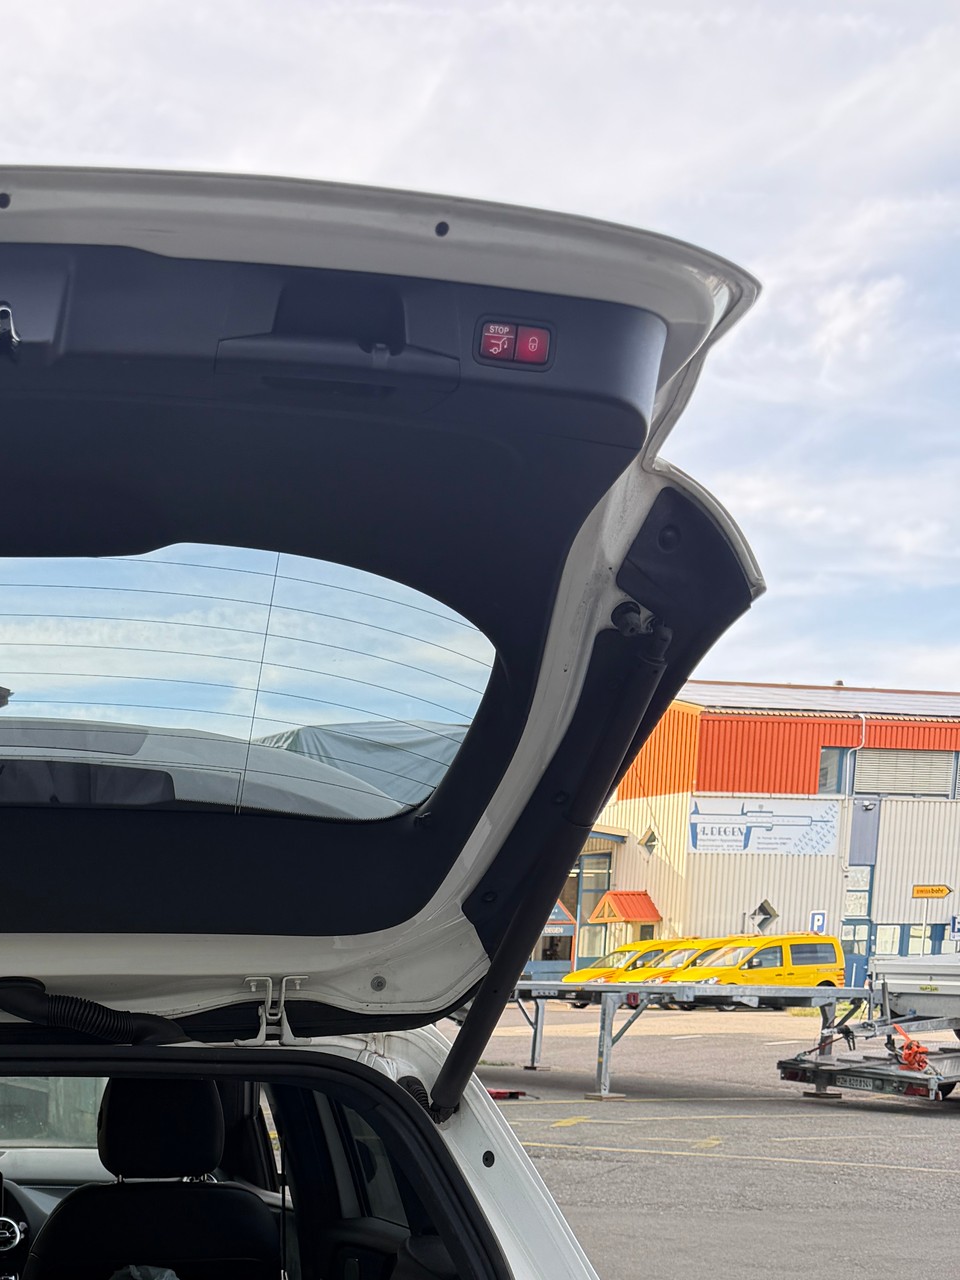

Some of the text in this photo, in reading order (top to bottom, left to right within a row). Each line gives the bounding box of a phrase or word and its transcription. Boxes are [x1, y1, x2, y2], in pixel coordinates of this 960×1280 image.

[489, 325, 509, 334] STOP
[710, 826, 744, 836] DEGEN
[814, 914, 823, 931] P
